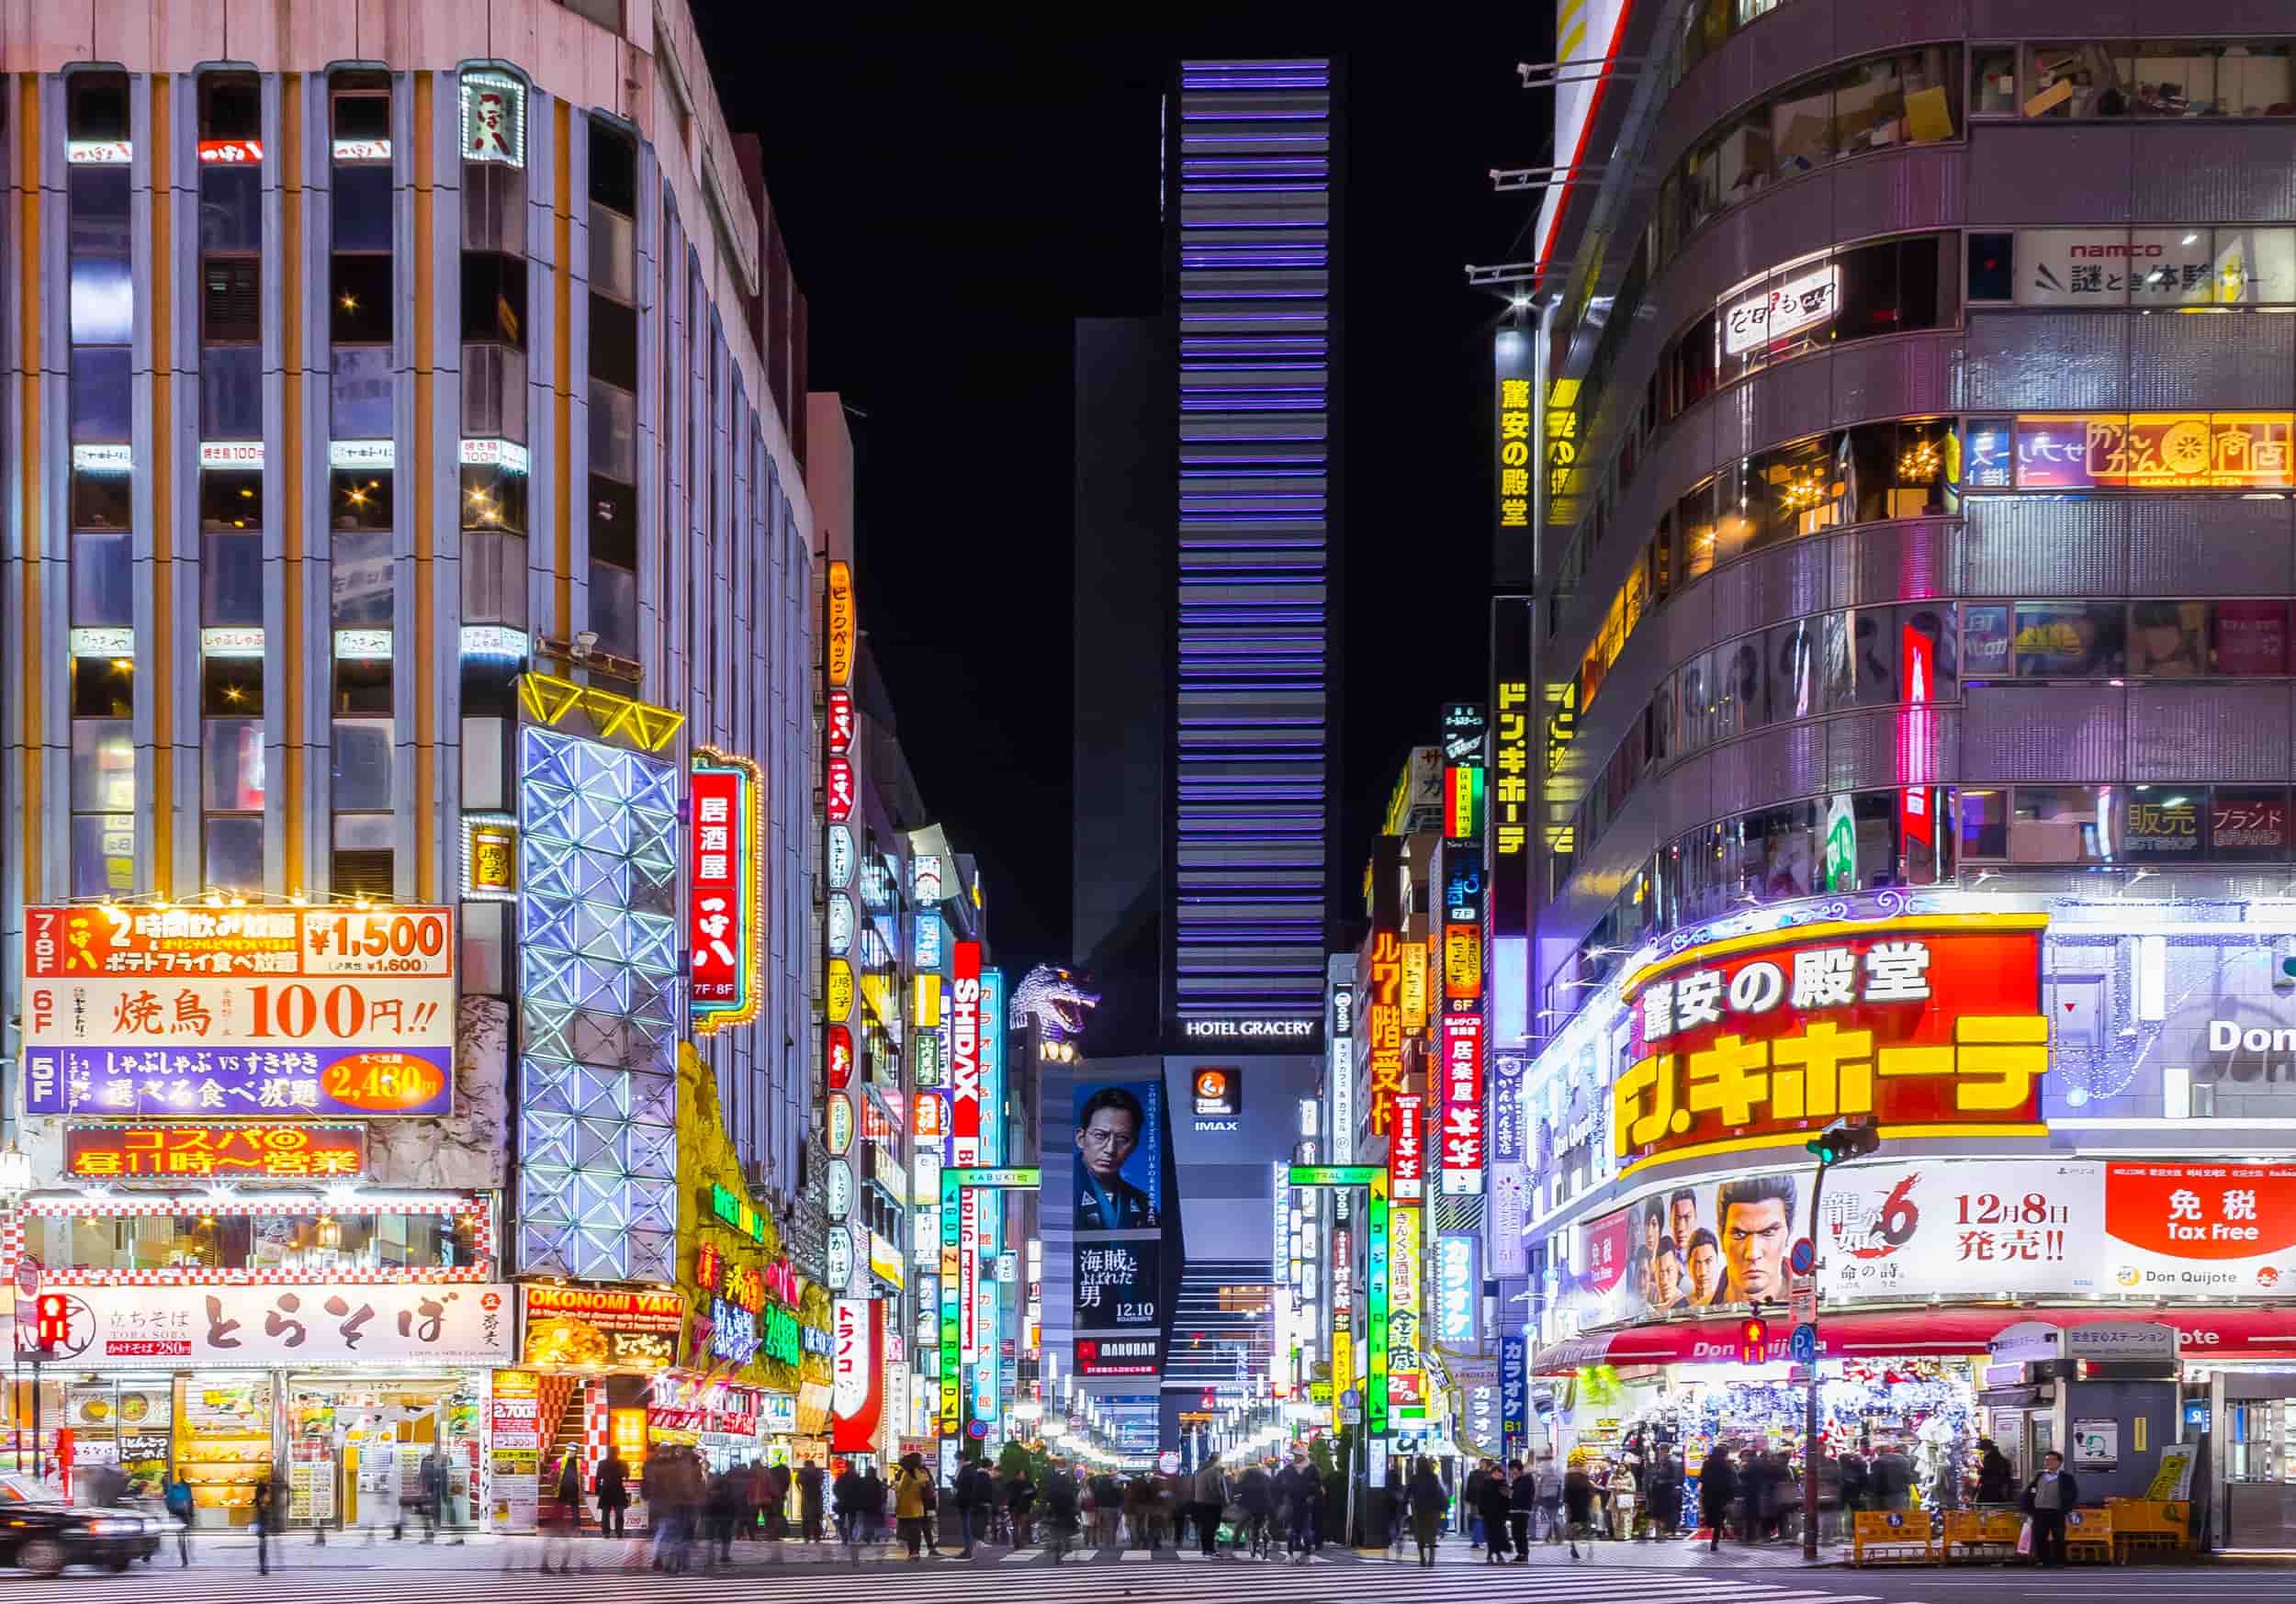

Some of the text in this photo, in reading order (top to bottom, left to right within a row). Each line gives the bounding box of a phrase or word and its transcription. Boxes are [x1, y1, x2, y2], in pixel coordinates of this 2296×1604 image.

[2070, 244, 2163, 258] namco
[1501, 379, 1529, 527] 驚安の殿堂
[2128, 803, 2197, 836] 販売
[2212, 808, 2283, 830] ブランド
[700, 797, 728, 879] 居酒屋
[66, 918, 97, 970] つぼ八
[310, 916, 443, 956] ¥1,500
[693, 897, 736, 967] つぼ八
[105, 952, 298, 973] ポテトフライ食べ放題
[1453, 1000, 1474, 1012] 6F
[1644, 941, 1931, 1044] 驚安の殿堂
[33, 990, 53, 1035] 6F
[112, 988, 212, 1037] 焼鳥
[1187, 1021, 1314, 1035] HOTEL GRACERY
[954, 979, 977, 1102] SHIDAX
[107, 1051, 213, 1074] しゃぶしゃぶ
[244, 1052, 320, 1074] すきやき
[31, 1057, 54, 1103] 5F
[107, 1077, 320, 1108] 選べる食べ放題
[1195, 1122, 1238, 1131] IMAX
[1874, 1171, 1922, 1247] 6
[1953, 1193, 2069, 1224] 12月8日
[2168, 1190, 2257, 1220] 免税
[1956, 1228, 2065, 1262] 発売!!
[2167, 1223, 2259, 1240] Tax Free
[1080, 1249, 1138, 1272] 海賊と
[1080, 1272, 1132, 1285] よばれた
[1443, 1240, 1470, 1336] カラオケ
[2146, 1270, 2237, 1287] Don Quijote
[529, 1289, 684, 1314] OKONOMI YAKI
[1079, 1285, 1101, 1307] 男
[1116, 1303, 1154, 1317] 12.10
[110, 1310, 191, 1328] 立ちそば
[205, 1291, 459, 1350] とらそば
[107, 1341, 155, 1354] かけそば
[837, 1307, 854, 1373] トラノコ
[1102, 1343, 1155, 1356] MARUHAN
[1693, 1341, 1735, 1357] Don
[944, 1340, 957, 1396] ROAD
[1504, 1343, 1523, 1418] カラオケ
[1473, 1385, 1491, 1448] カラオケ
